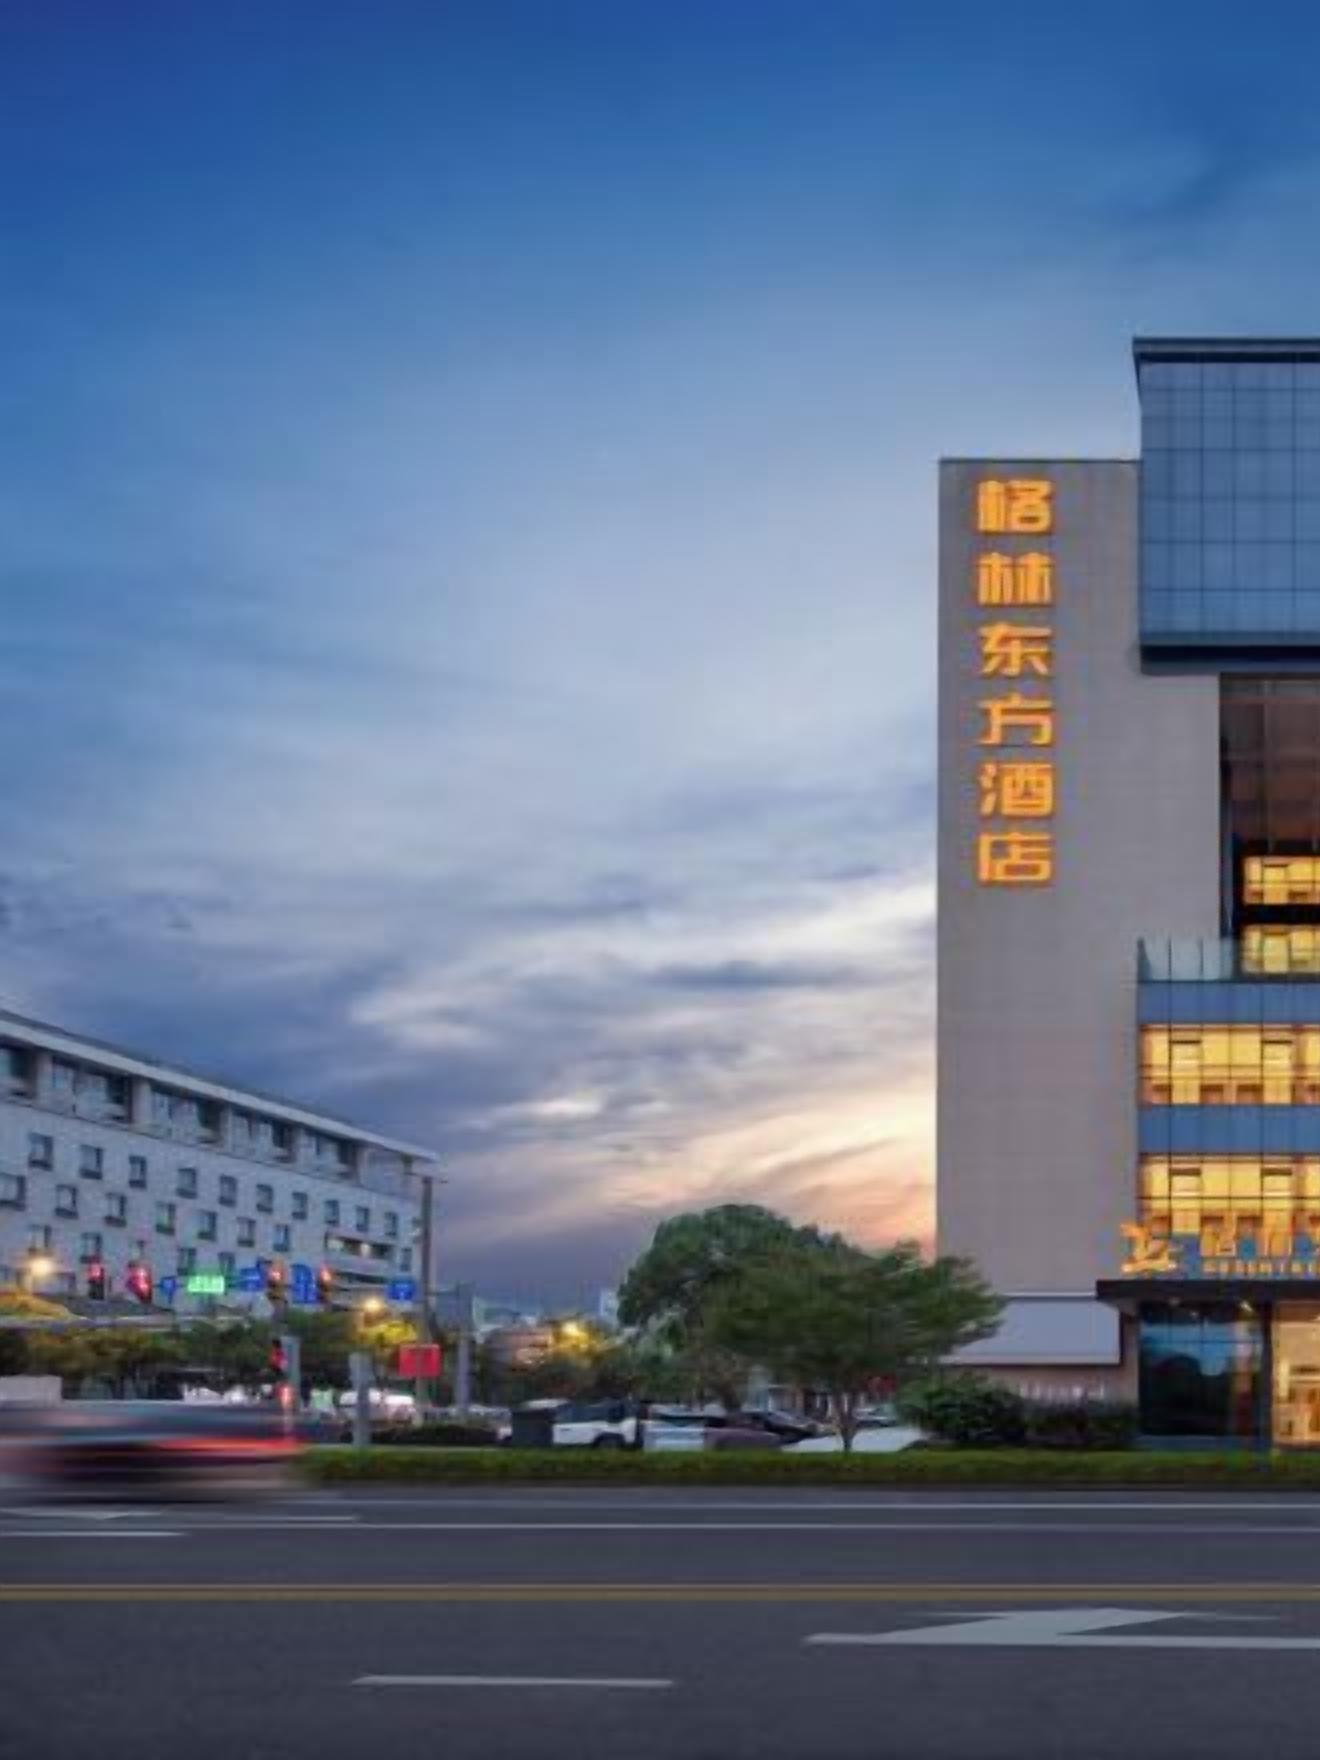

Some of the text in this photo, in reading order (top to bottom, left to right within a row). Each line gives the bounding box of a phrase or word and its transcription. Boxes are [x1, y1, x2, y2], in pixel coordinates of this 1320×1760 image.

[976, 478, 1055, 885] 格林东方酒店
